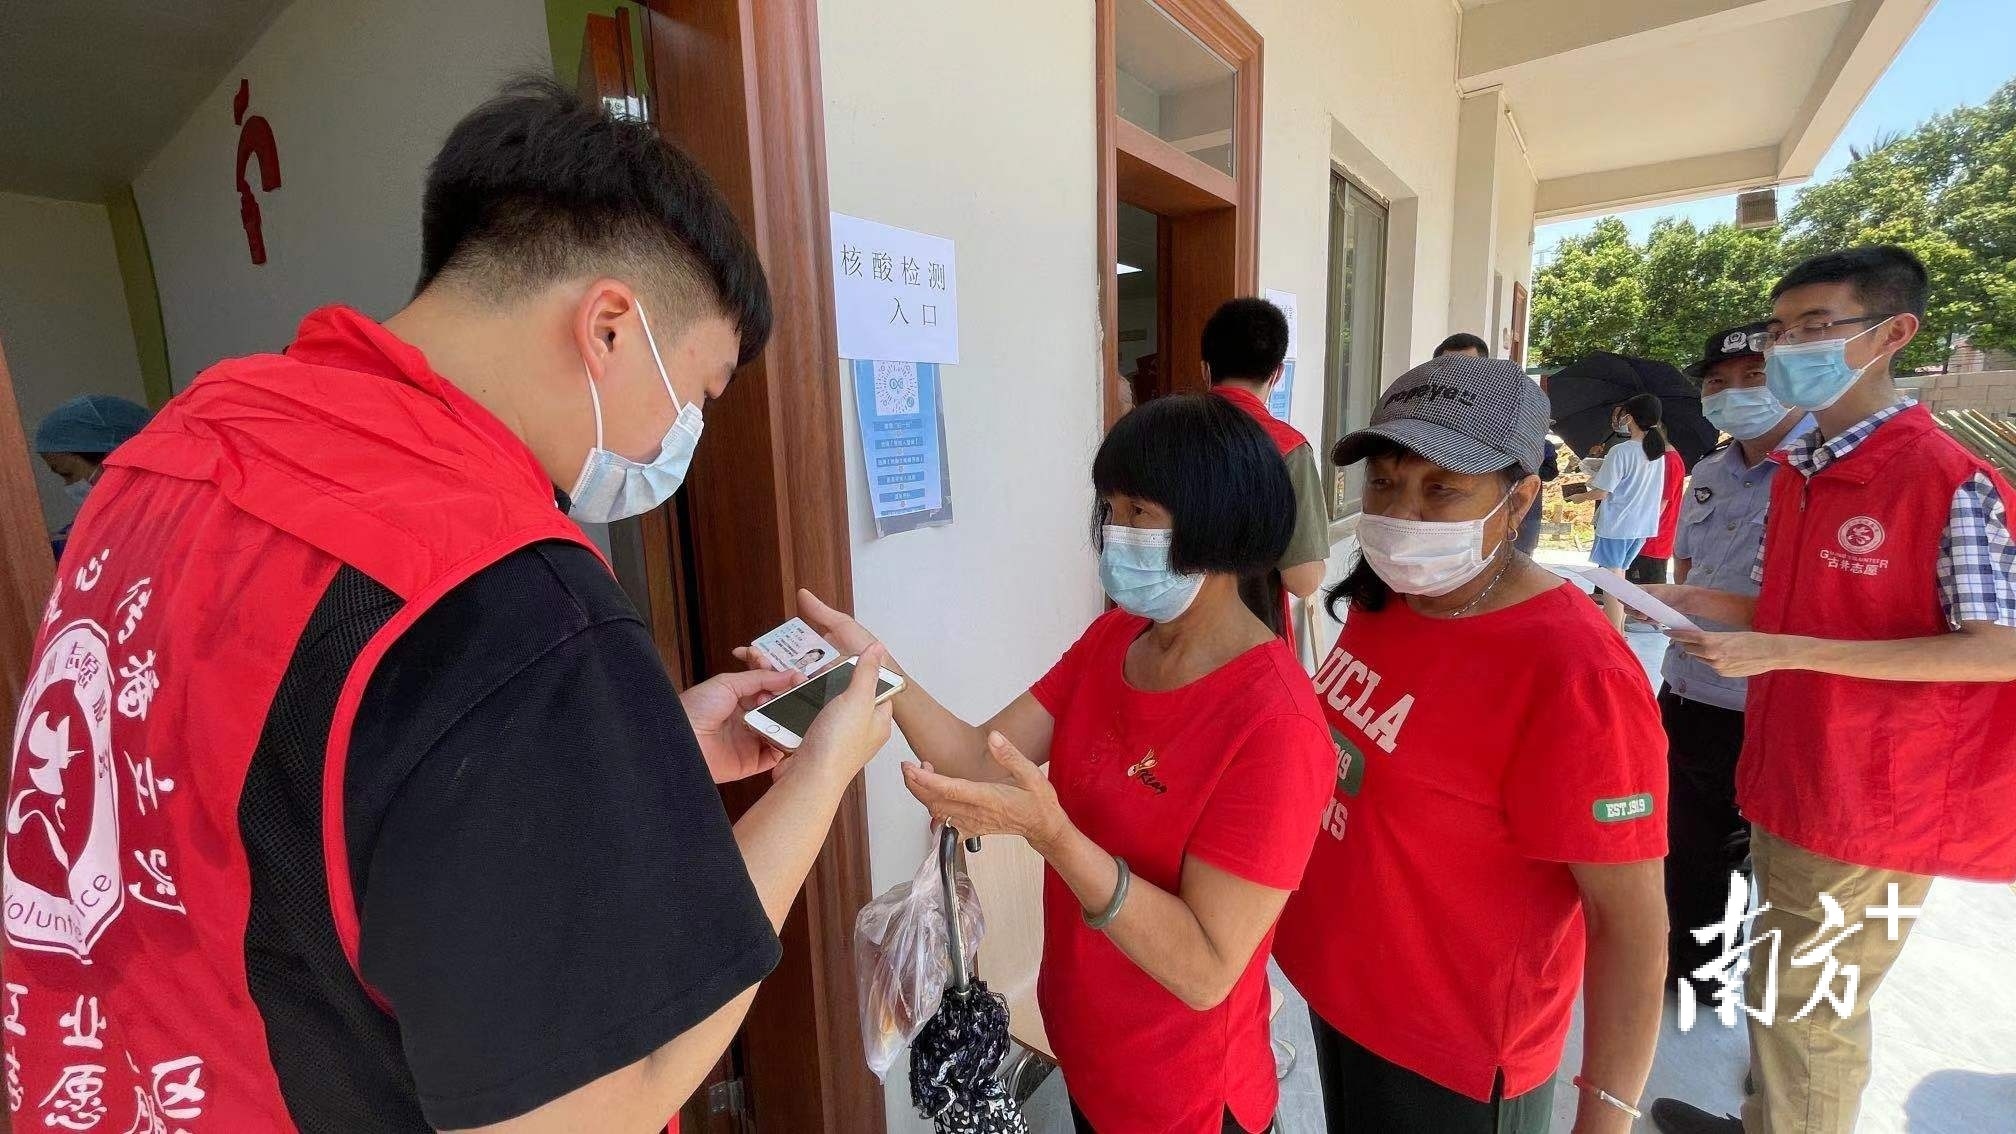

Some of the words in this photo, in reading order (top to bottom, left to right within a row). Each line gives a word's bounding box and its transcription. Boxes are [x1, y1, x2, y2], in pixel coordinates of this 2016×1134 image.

[840, 244, 946, 291] 核酸检测
[890, 297, 937, 327] 入口
[1313, 646, 1415, 754] UCLA
